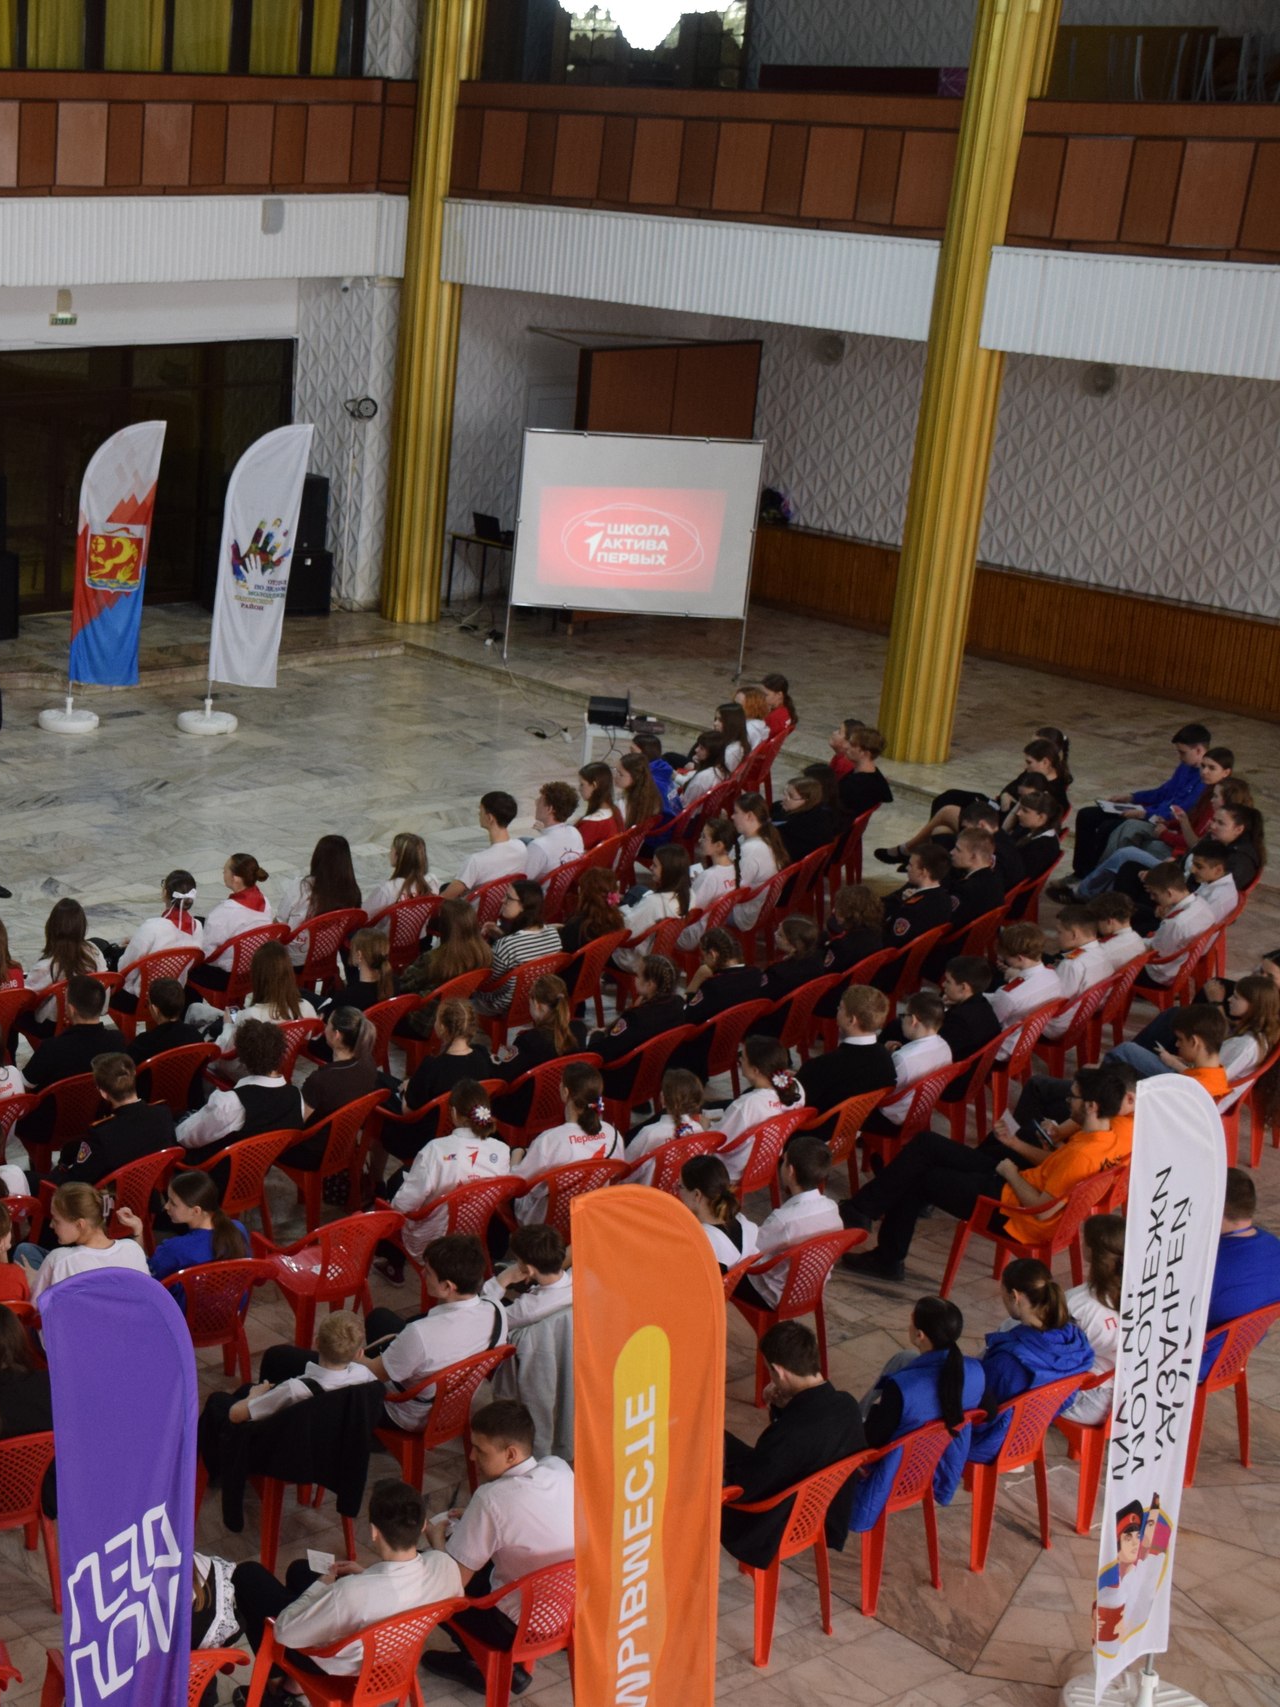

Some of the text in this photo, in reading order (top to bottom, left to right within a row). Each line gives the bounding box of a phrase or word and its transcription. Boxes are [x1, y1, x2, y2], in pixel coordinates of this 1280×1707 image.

[607, 523, 670, 536] ШКОЛА
[602, 538, 668, 551] АКТИВА
[597, 552, 667, 565] ПЕРВЫХ
